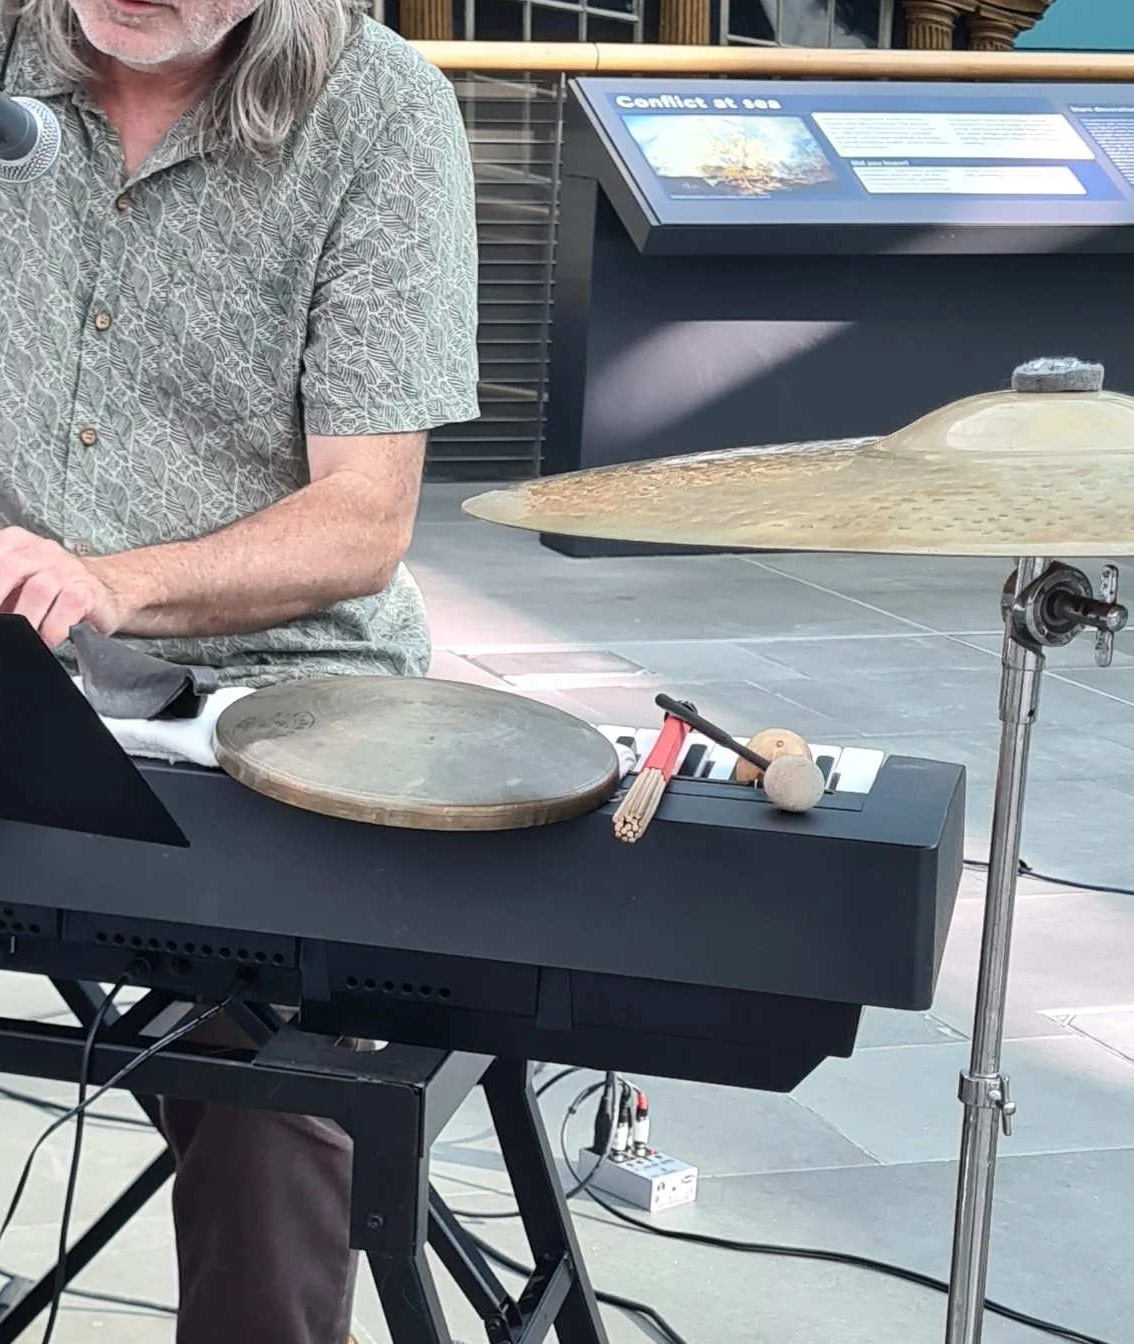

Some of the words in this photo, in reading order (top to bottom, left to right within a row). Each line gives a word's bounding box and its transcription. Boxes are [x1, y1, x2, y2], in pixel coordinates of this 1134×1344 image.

[615, 94, 709, 110] Conflict
[713, 97, 739, 109] at
[742, 98, 782, 110] sea
